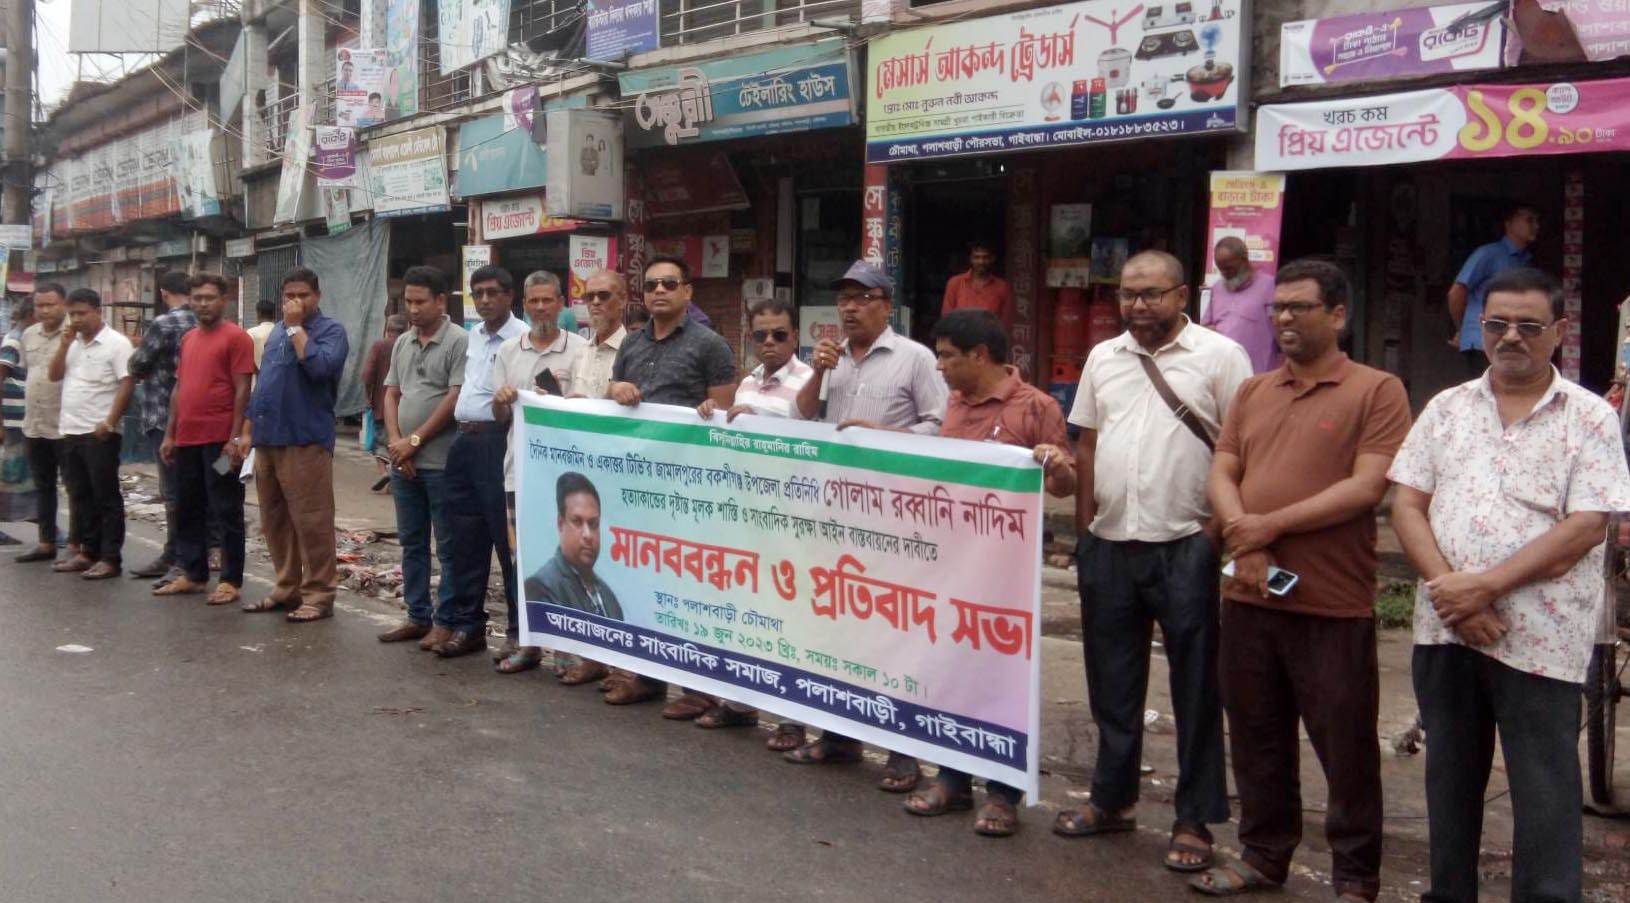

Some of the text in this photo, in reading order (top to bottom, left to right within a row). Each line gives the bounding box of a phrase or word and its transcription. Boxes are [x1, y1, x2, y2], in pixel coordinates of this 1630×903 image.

[740, 79, 794, 109] টেইলারিং
[797, 73, 837, 102] হাউস
[877, 13, 1079, 99] মেসার্স আকন্দ ট্রেডার্স
[902, 101, 919, 113] মোঃ
[964, 90, 999, 104] আকন্দ
[1278, 123, 1327, 159] প্রিয়
[1331, 113, 1441, 154] এজেন্টে
[1323, 106, 1389, 125] খরচ কম
[528, 438, 548, 460] দৈনিক
[549, 444, 585, 466] মানবজমিন
[587, 454, 594, 468] ও
[596, 455, 624, 473] একাত্তর
[655, 462, 703, 487] জামালপুরের
[706, 463, 743, 491] বকশীগঞ্জ
[744, 471, 780, 498] উপজেলা
[783, 475, 820, 504] প্রতিনিধি
[823, 476, 886, 517] গোলাম
[890, 485, 956, 531] রব্বানি
[961, 493, 1027, 541] নাদিম
[668, 491, 690, 521] দৃষ্টান্ত
[692, 499, 714, 523] মূলক
[718, 497, 739, 522] শাস্তি
[742, 508, 748, 523] ও
[750, 505, 790, 532] সাংবাদিক
[792, 515, 817, 539] সুরক্ষা
[819, 517, 846, 544] আইন
[849, 526, 899, 554] বাস্তবায়নের
[903, 531, 939, 562] দাবীতে
[609, 525, 1034, 661] মানববন্ধন ও প্রতিবাদ সভা
[654, 589, 785, 634] স্থানঃ পলাশবাড়ী চৌমাথা
[545, 610, 1017, 759] আয়োজনেঃ সাংবাদিক সমাজ, পলাশবাড়ী, গাইবান্ধা
[654, 610, 689, 633] তারিখঃ
[693, 622, 708, 637] ১৯
[713, 625, 734, 645] জুন
[738, 633, 773, 653] ২০২৩
[805, 648, 838, 670] সময়ঃ
[842, 658, 877, 682] সকাল
[882, 672, 899, 690] ১০
